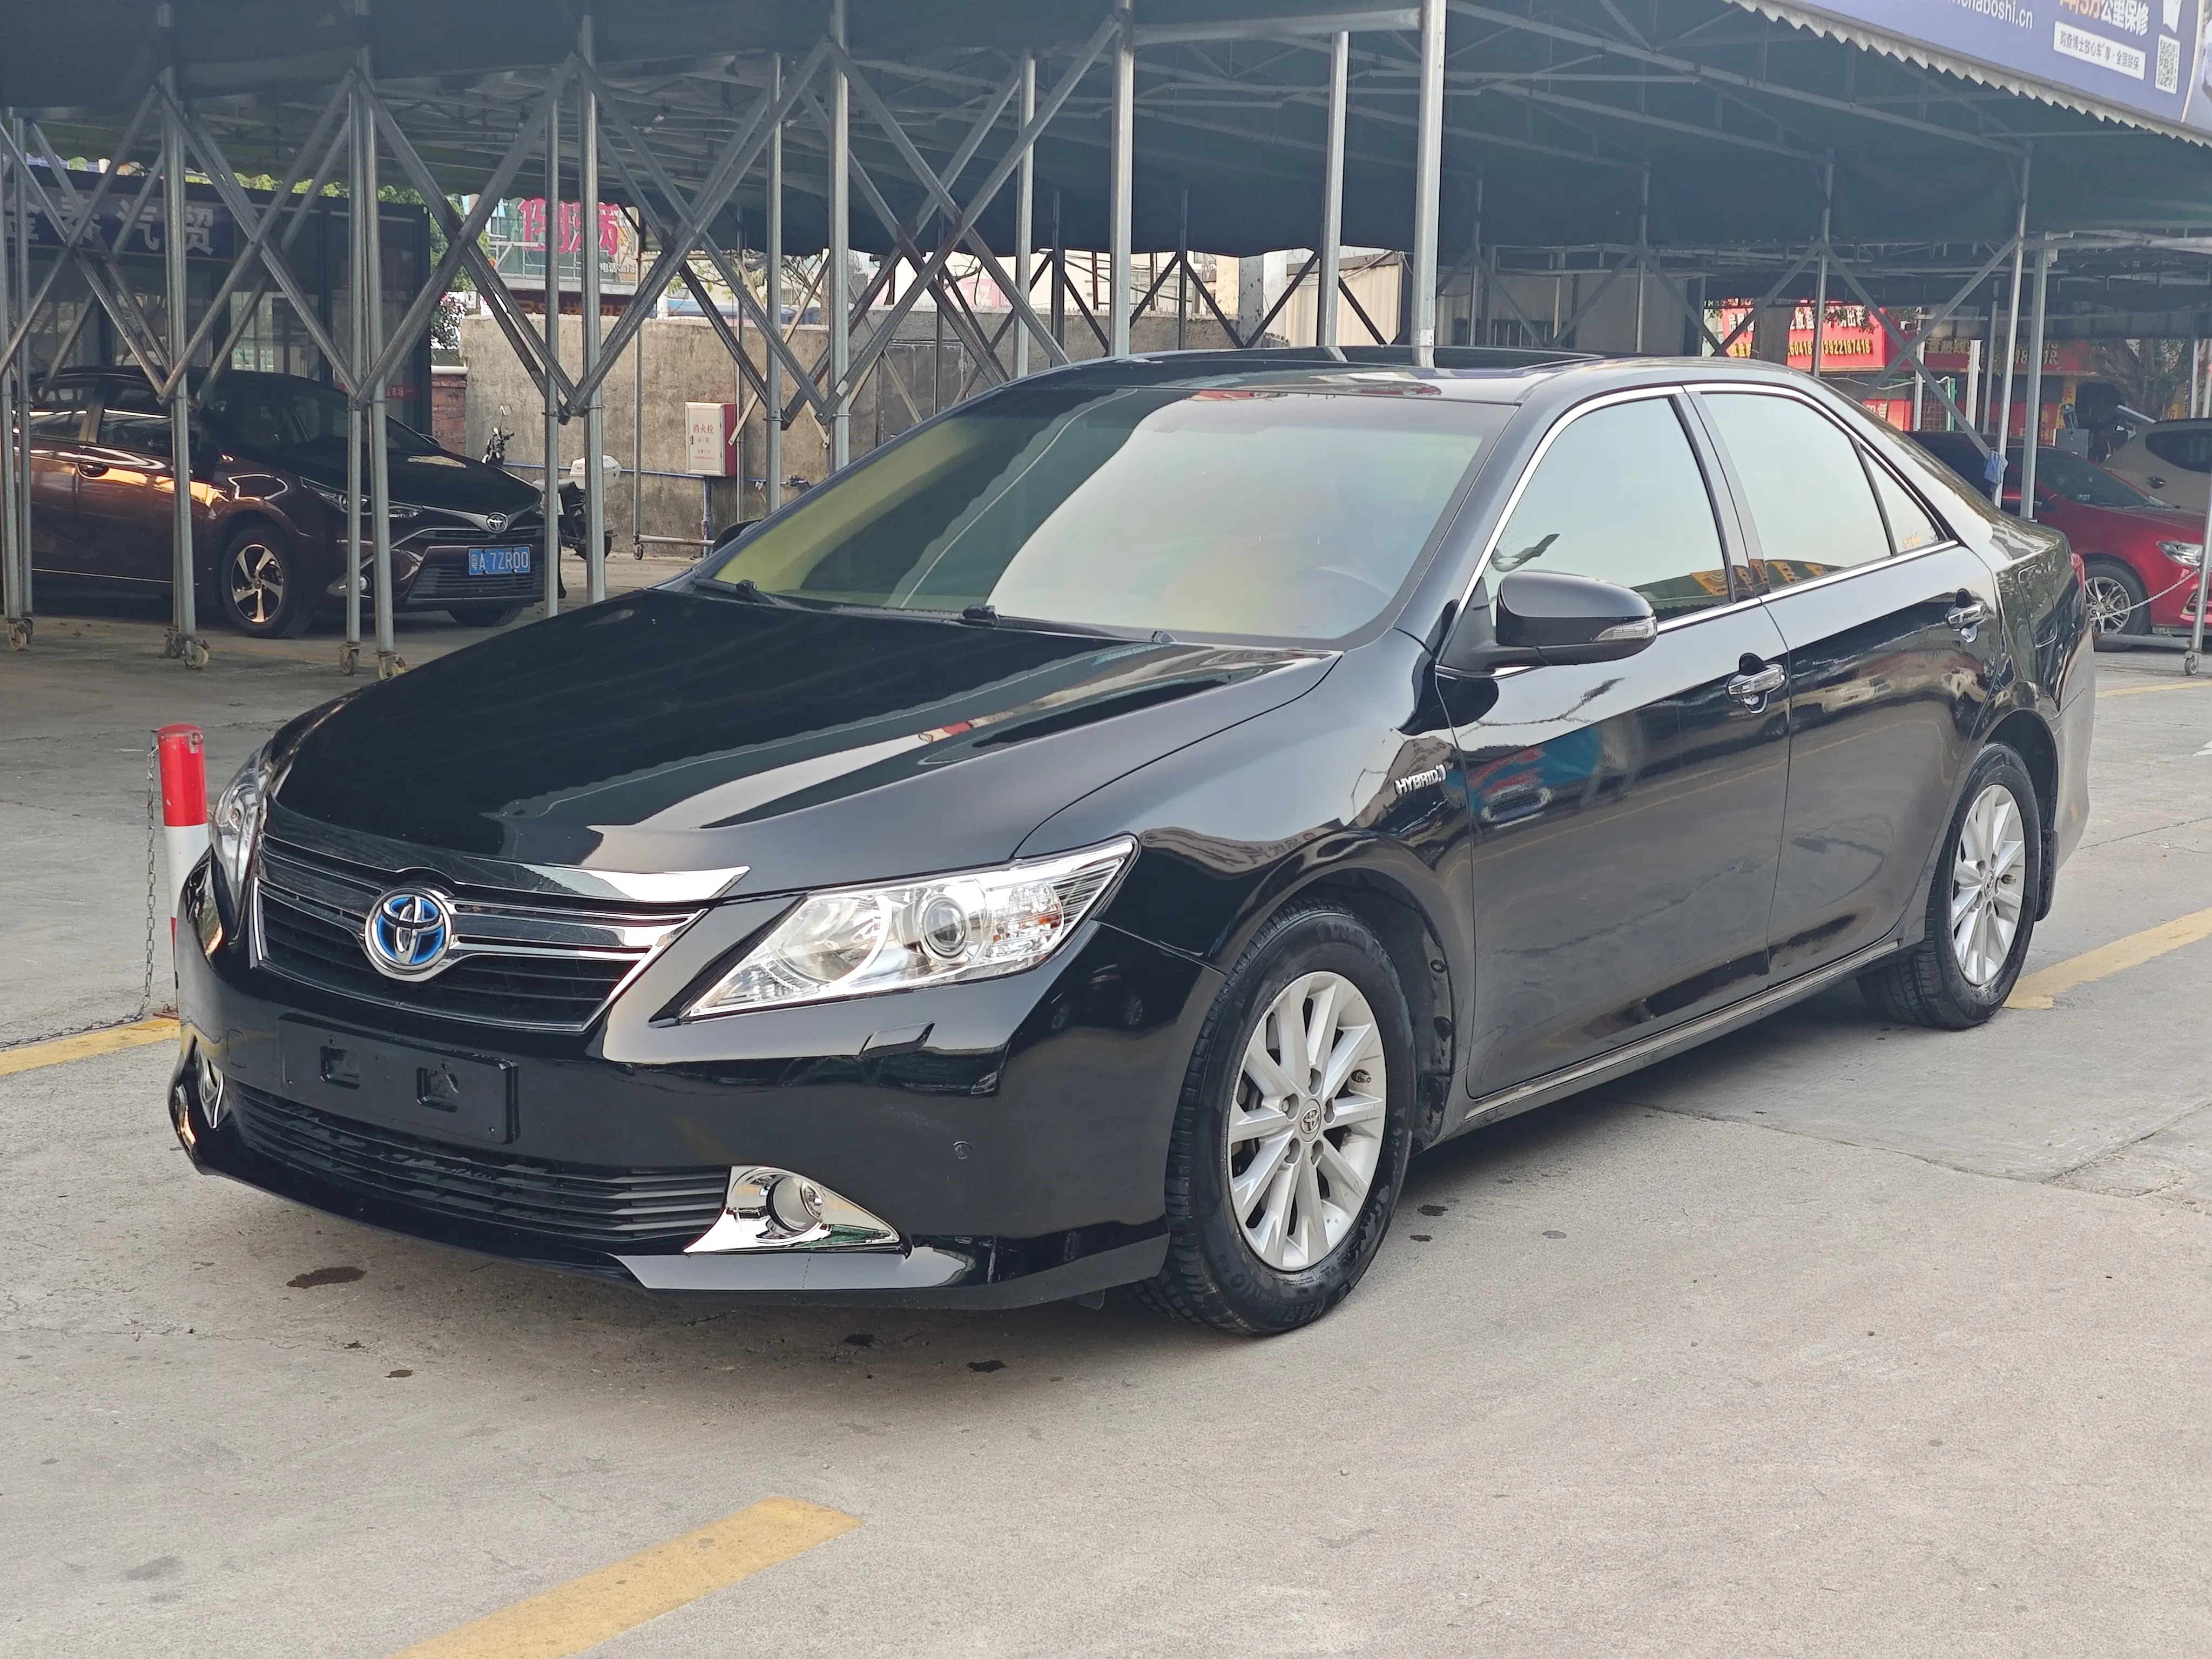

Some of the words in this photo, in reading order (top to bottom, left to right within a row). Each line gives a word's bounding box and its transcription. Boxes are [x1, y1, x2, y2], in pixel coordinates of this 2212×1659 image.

[693, 423, 714, 434] 消火栓
[1395, 768, 1439, 795] HYBRID
